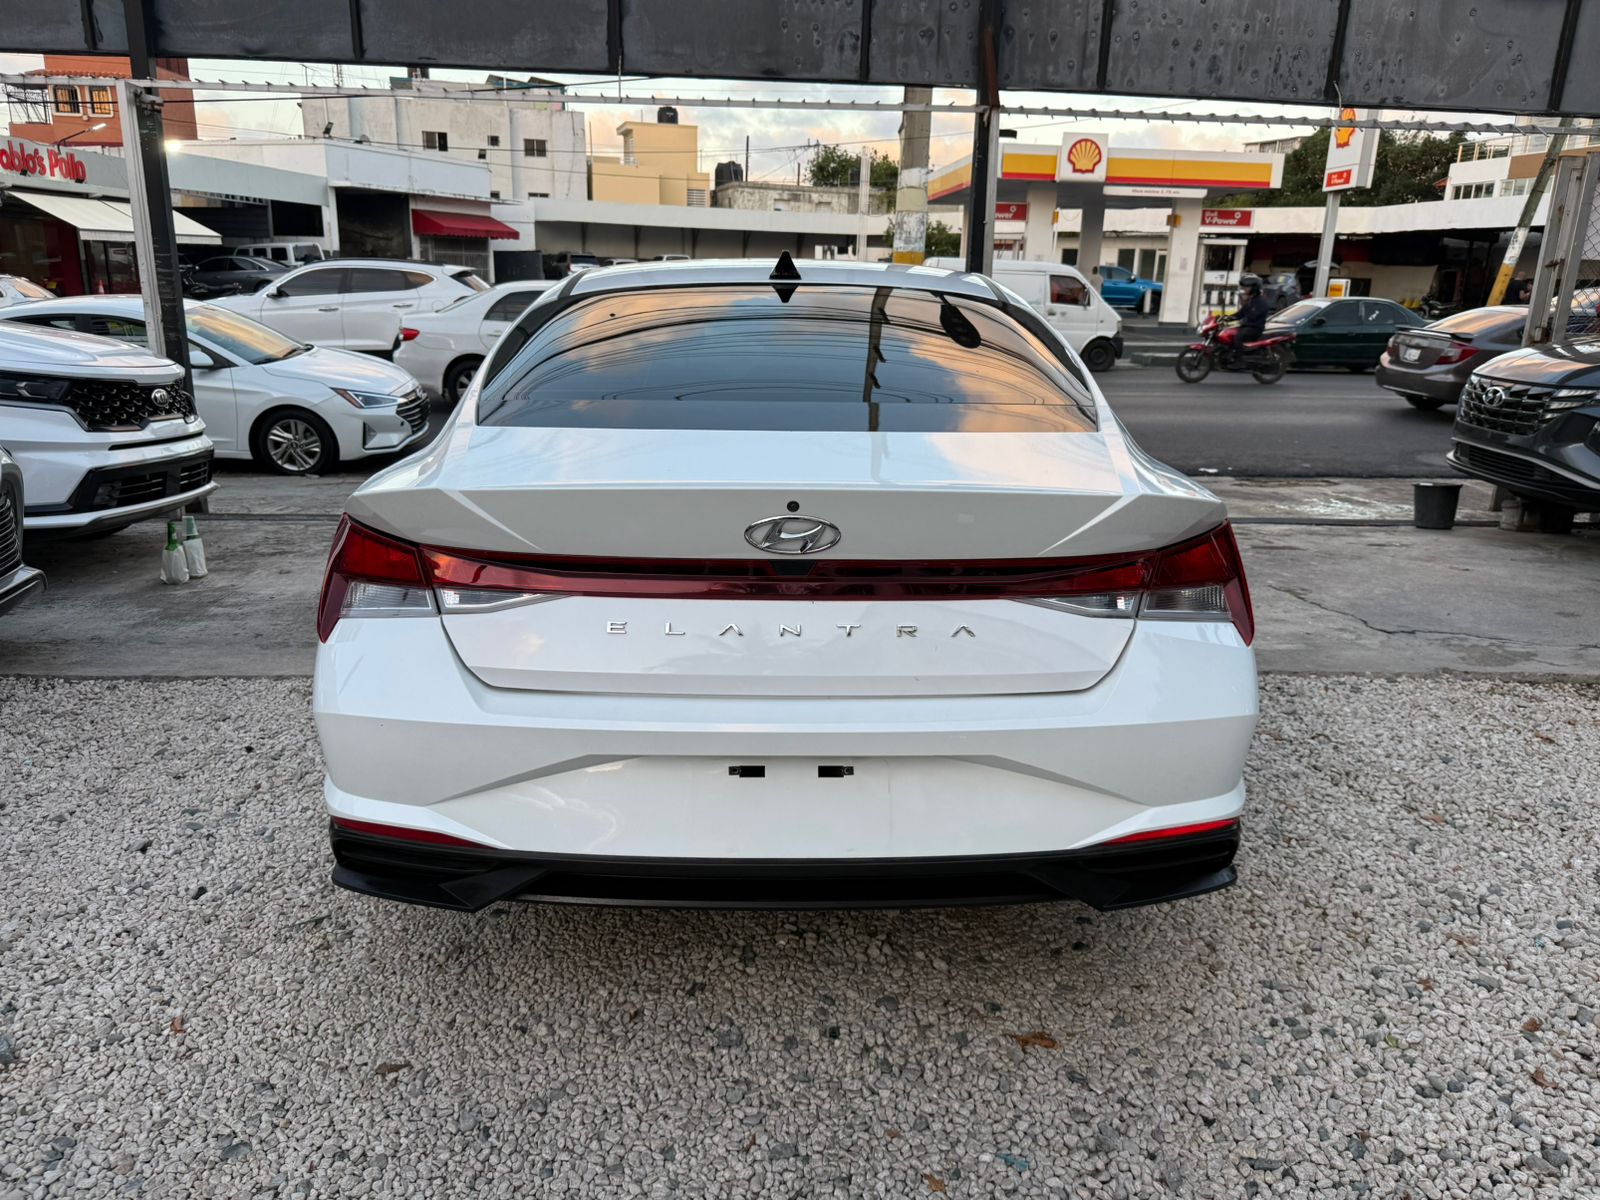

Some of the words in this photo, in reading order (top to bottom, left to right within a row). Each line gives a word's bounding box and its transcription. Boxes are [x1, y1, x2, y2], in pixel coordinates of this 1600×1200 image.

[47, 148, 87, 183] Pollo
[1204, 216, 1238, 224] V-Power
[606, 621, 976, 637] ELANTRA
